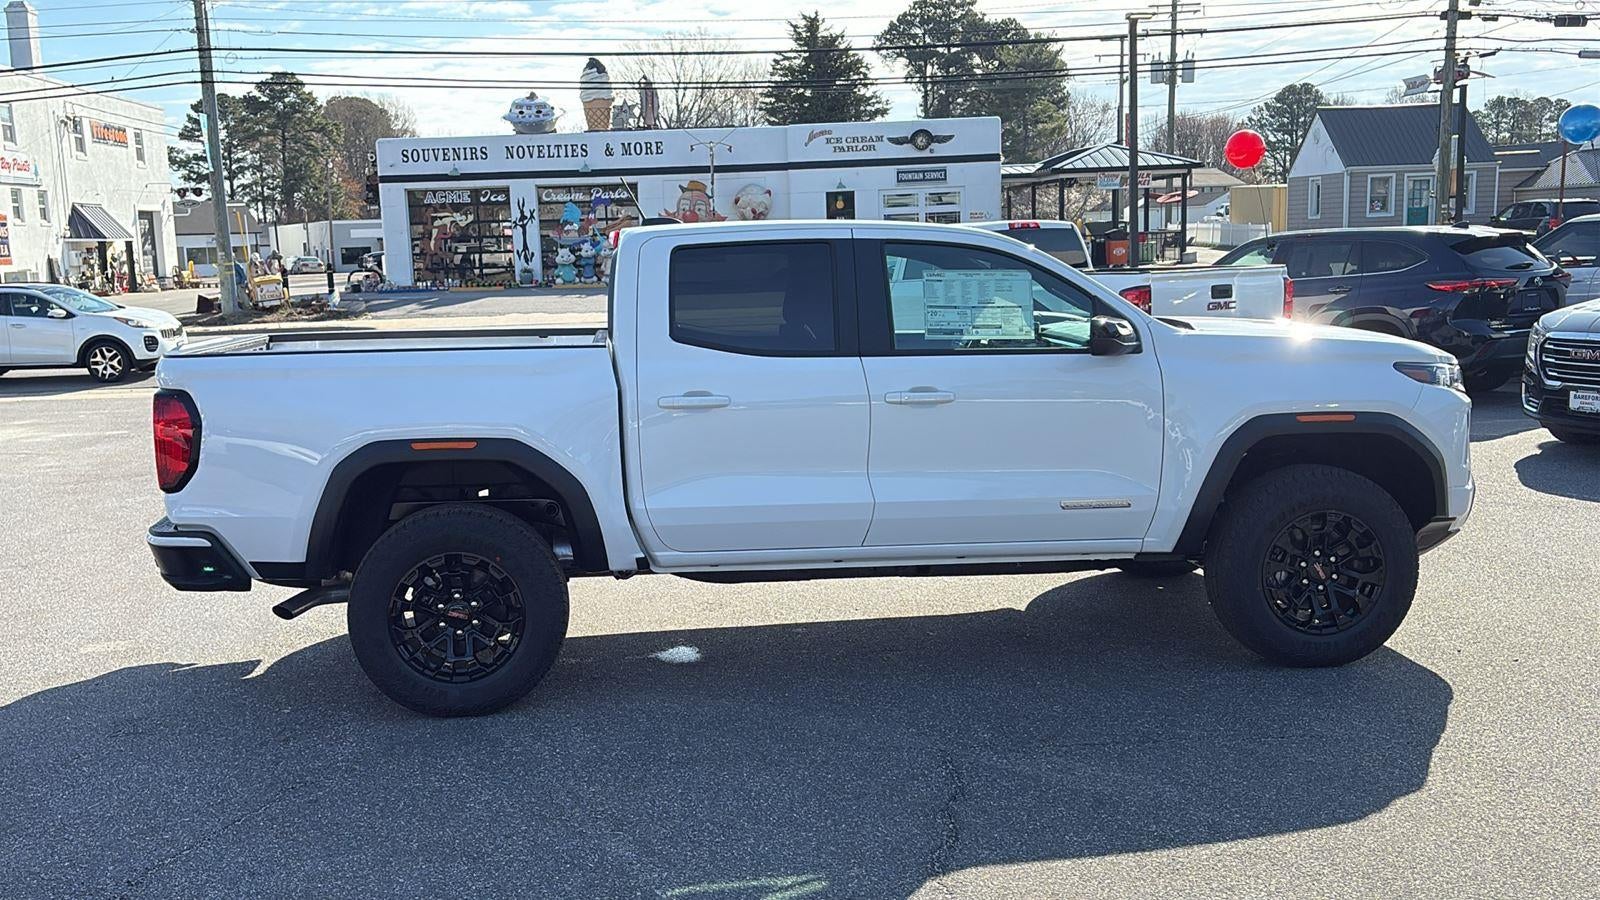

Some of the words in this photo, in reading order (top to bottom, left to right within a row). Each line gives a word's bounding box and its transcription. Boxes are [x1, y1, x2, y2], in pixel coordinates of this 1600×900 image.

[91, 121, 128, 144] Firestone
[825, 136, 843, 144] ICE
[846, 135, 884, 144] CREAM
[401, 147, 488, 163] SOUVENIRS
[505, 144, 588, 159] NOVELTIES
[604, 142, 615, 157] &
[621, 141, 664, 156] MORE
[832, 144, 876, 153] PARLOR
[898, 172, 923, 180] FOUNTAIN
[924, 171, 945, 179] SERVICE
[424, 190, 471, 204] ACME
[480, 189, 507, 202] Ice
[542, 186, 583, 201] Cream
[591, 187, 631, 200] Parlo
[1207, 301, 1237, 311] GMC
[1570, 349, 1600, 360] GM
